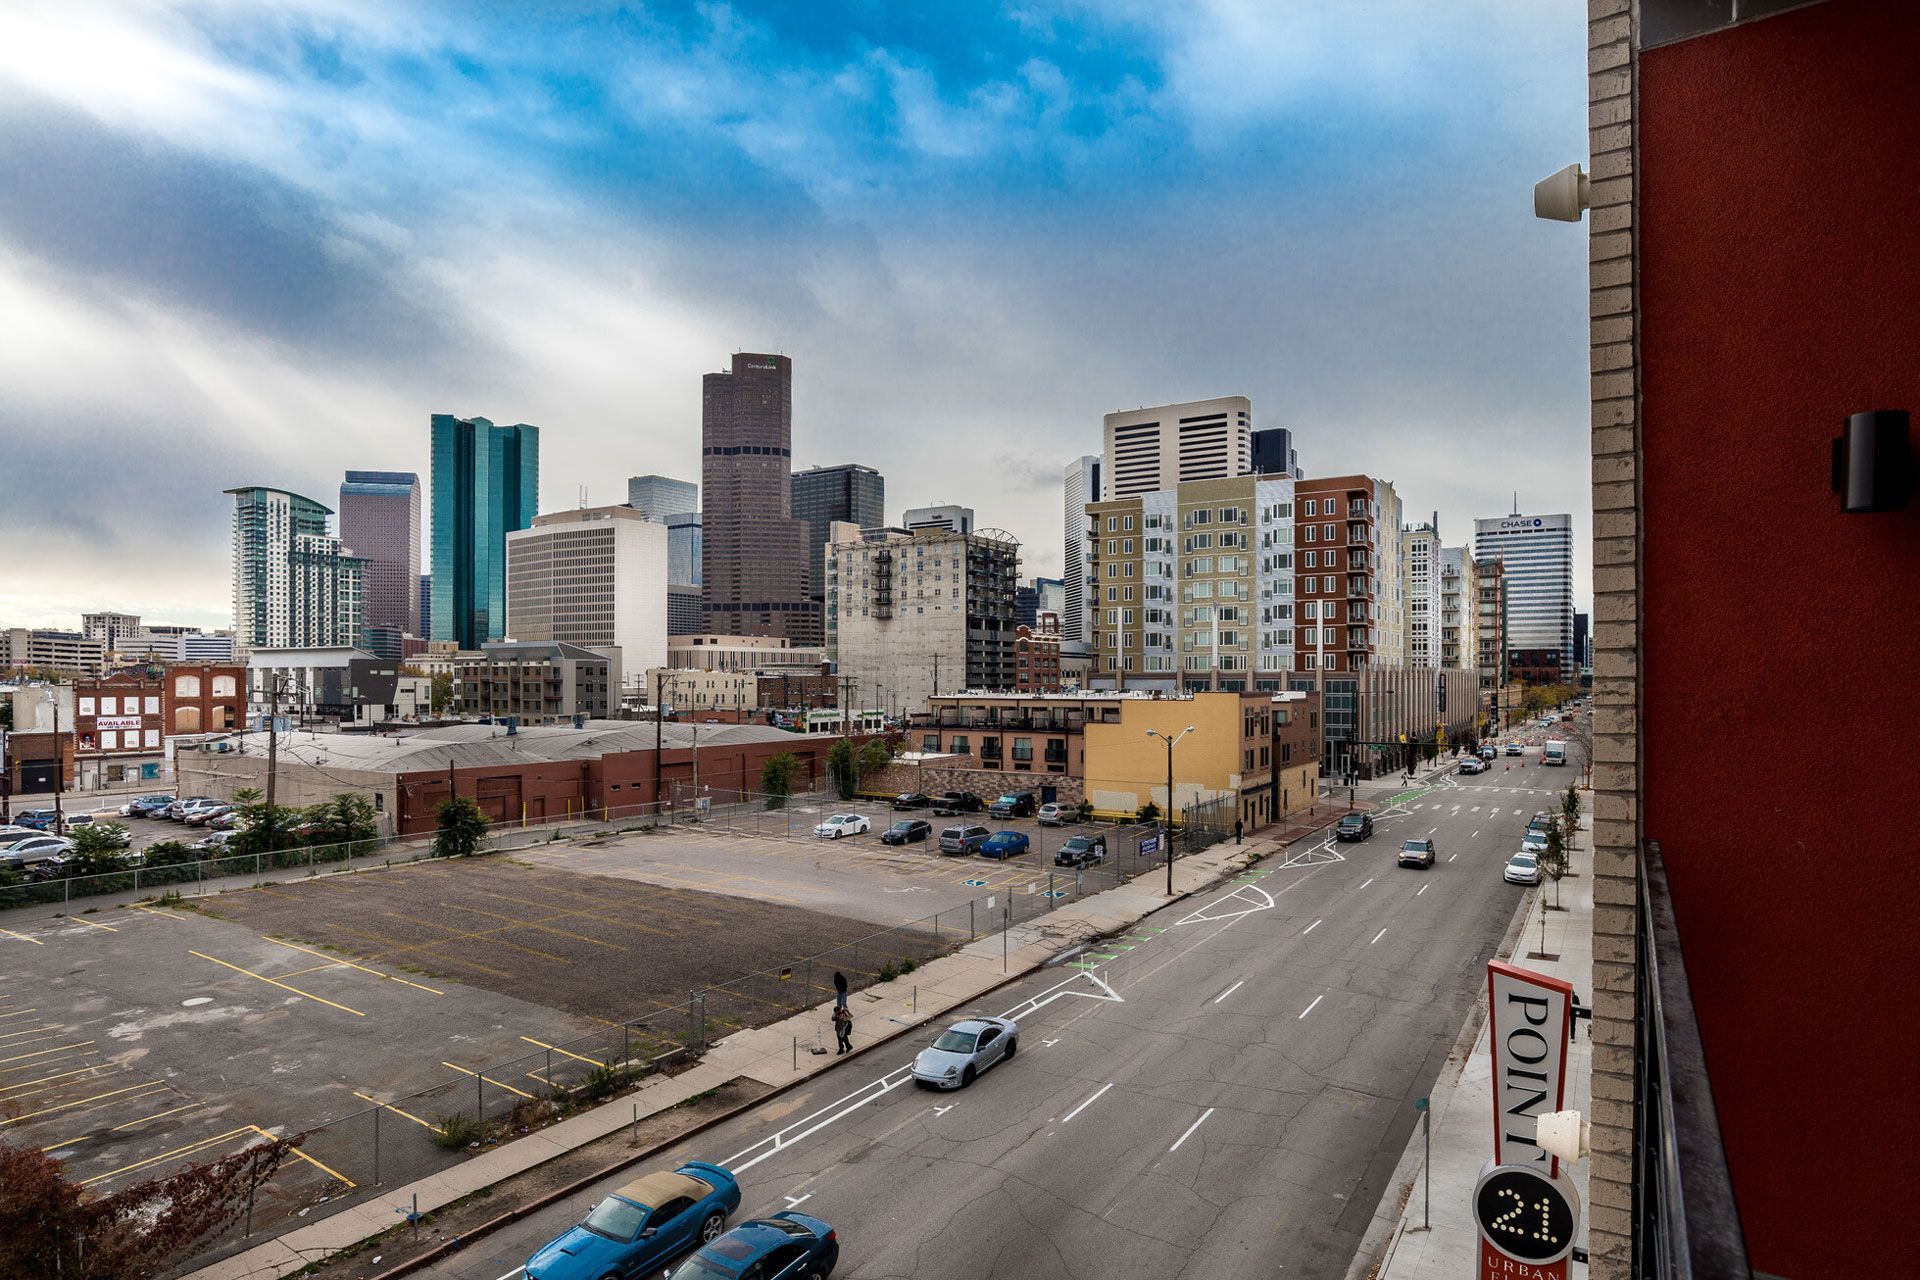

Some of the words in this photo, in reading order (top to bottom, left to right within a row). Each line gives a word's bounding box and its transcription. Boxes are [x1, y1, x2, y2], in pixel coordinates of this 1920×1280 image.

[1501, 520, 1532, 528] CHASE
[1491, 1188, 1558, 1244] 21
[1488, 1256, 1560, 1280] URBAN
